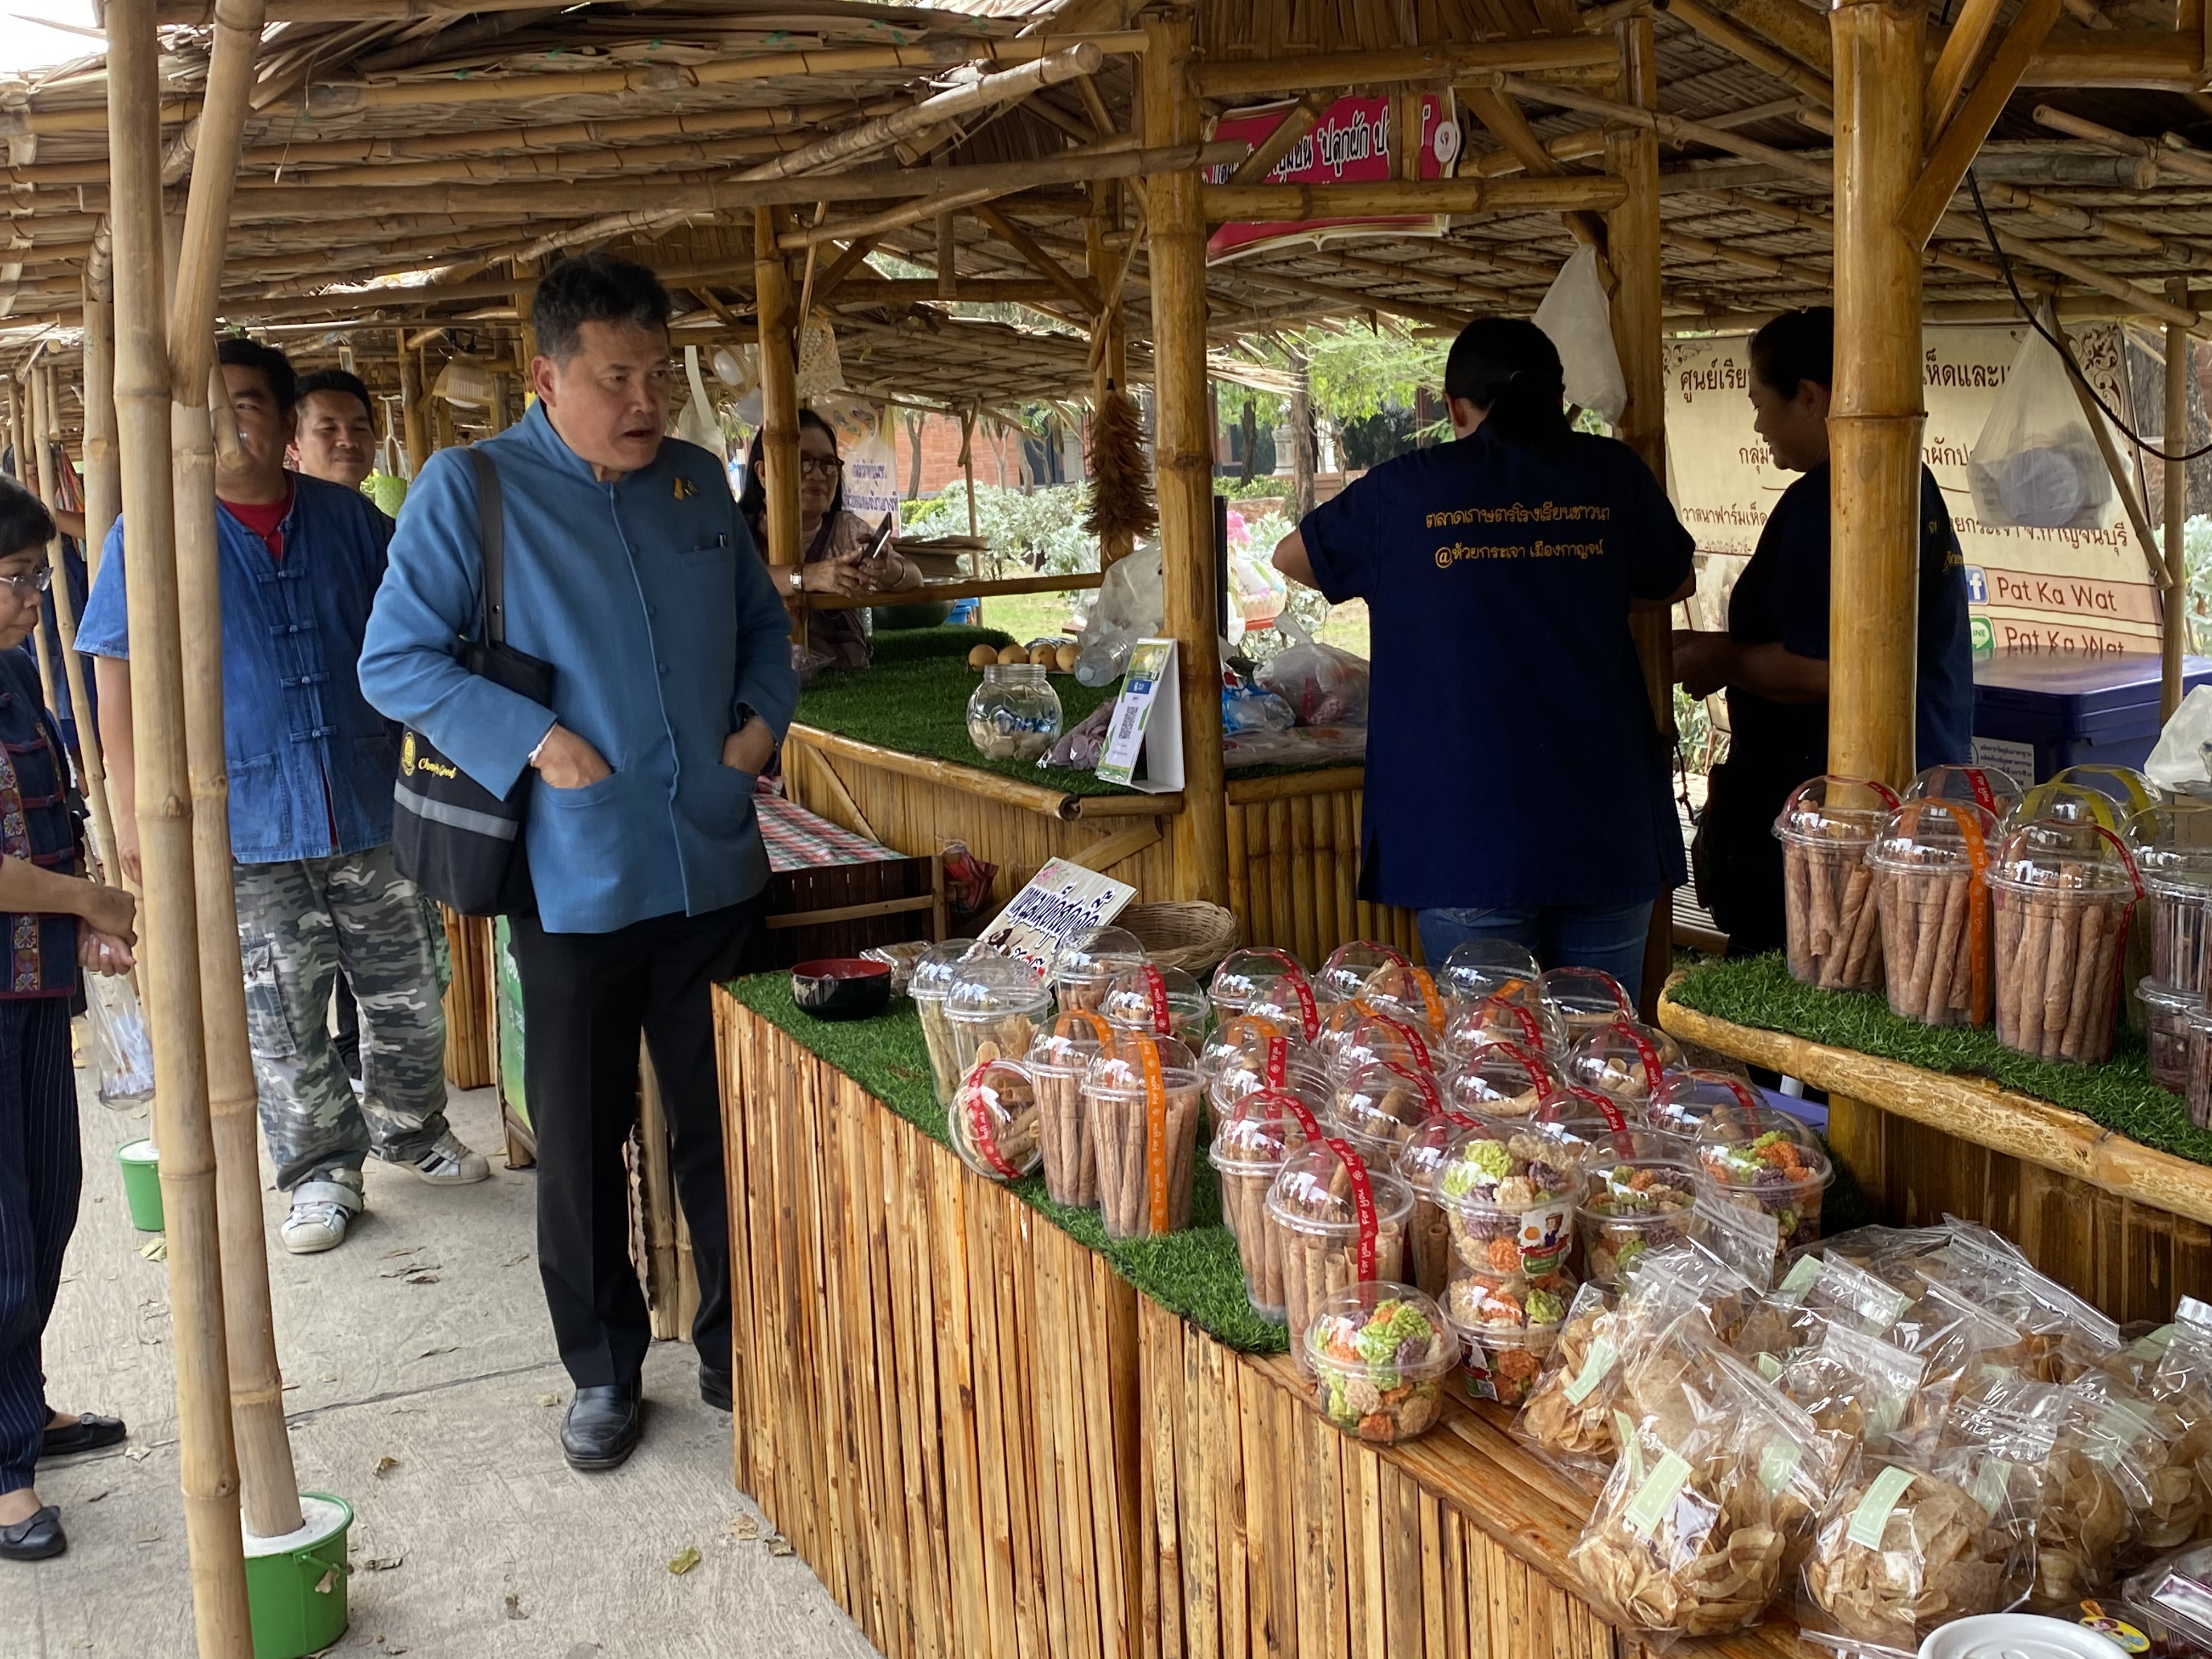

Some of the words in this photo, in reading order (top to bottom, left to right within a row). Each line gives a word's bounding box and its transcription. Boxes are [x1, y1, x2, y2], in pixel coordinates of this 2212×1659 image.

[1680, 358, 1749, 403] ศูนย์เรีย
[1739, 439, 1773, 475] กลุ่ม
[1997, 576, 2032, 602] Pat
[2036, 581, 2064, 606] Ka
[2070, 584, 2118, 612] Wat
